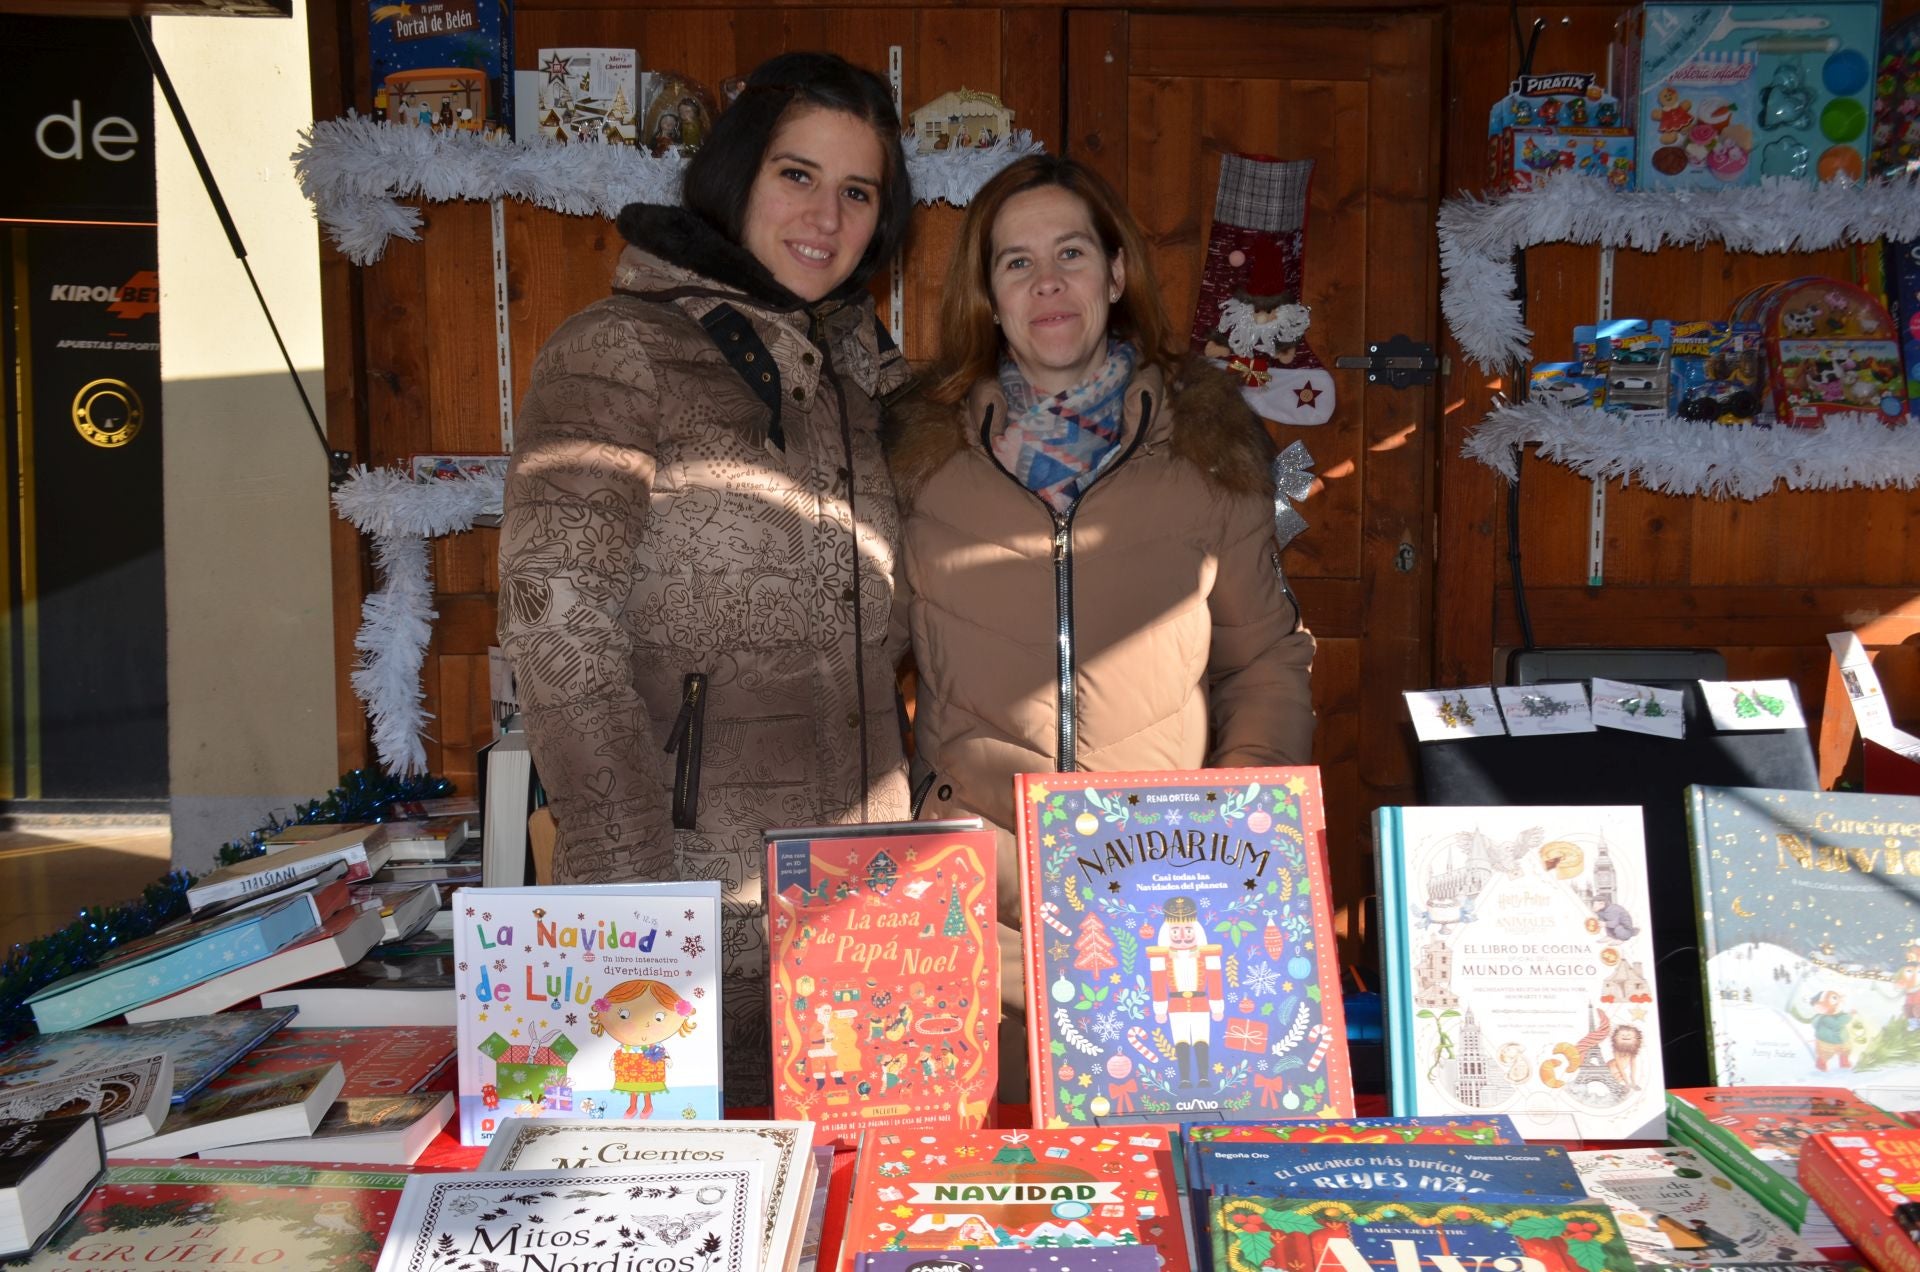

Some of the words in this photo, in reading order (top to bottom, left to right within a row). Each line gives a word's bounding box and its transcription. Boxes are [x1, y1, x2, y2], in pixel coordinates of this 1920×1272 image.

[396, 16, 429, 38] Portal
[431, 14, 444, 32] de
[445, 9, 473, 30] Belén
[608, 55, 627, 63] Merry
[604, 63, 633, 71] Christmas
[1526, 76, 1585, 91] PIRATIX
[35, 98, 140, 162] de
[56, 339, 114, 351] APUESTAS
[1671, 343, 1712, 357] TRUCKS
[1146, 794, 1169, 804] RENA
[1169, 793, 1200, 803] ORTEGA
[1814, 811, 1920, 837] Cancione
[1076, 829, 1271, 884] NAVIDARIUM
[240, 866, 298, 893] INVISIBLE
[1152, 873, 1171, 882] Casi
[1172, 872, 1196, 881] todas
[1196, 872, 1210, 881] las
[1136, 881, 1179, 891] Navidades
[1180, 881, 1195, 890] del
[1195, 881, 1228, 892] planeta
[844, 908, 870, 931] La
[876, 910, 920, 930] casa
[1496, 915, 1557, 928] ANIMALES
[476, 923, 514, 950] La
[536, 919, 658, 953] Navidad
[816, 927, 836, 945] de
[833, 933, 898, 974] Papá
[898, 945, 959, 977] Noel
[1463, 944, 1476, 954] EL
[1481, 944, 1519, 954] LIBRO
[1522, 944, 1538, 954] DE
[1541, 944, 1592, 954] COCINA
[602, 955, 613, 963] Un
[614, 955, 634, 963] libro
[635, 956, 679, 965] interactivo
[603, 966, 680, 978] divertidísimo
[1461, 964, 1524, 976] MUNDO
[475, 964, 512, 1003] de
[525, 964, 593, 1005] Lulú
[872, 1107, 898, 1116] INCLUYE
[831, 1123, 847, 1131] LIBRO
[597, 1142, 725, 1164] Cuentos
[1214, 1152, 1250, 1160] Begoña
[1273, 1168, 1294, 1180] EL
[1294, 1156, 1365, 1175] ENCARGO
[1369, 1155, 1404, 1168] MÁS
[1408, 1156, 1465, 1176] DIFÍCIL
[1469, 1169, 1494, 1182] DE
[123, 1168, 170, 1184] JULIA
[173, 1169, 273, 1184] DONALDSON
[290, 1172, 347, 1186] AXEL
[1311, 1171, 1409, 1190] REYES
[933, 1184, 1097, 1201] NAVIDAD
[1665, 1181, 1692, 1190] de
[1363, 1227, 1401, 1235] MAREN
[1404, 1227, 1442, 1236] TJELTA
[1444, 1228, 1467, 1236] THU
[467, 1222, 592, 1256] Mitos
[520, 1251, 696, 1272] Nórdicos
